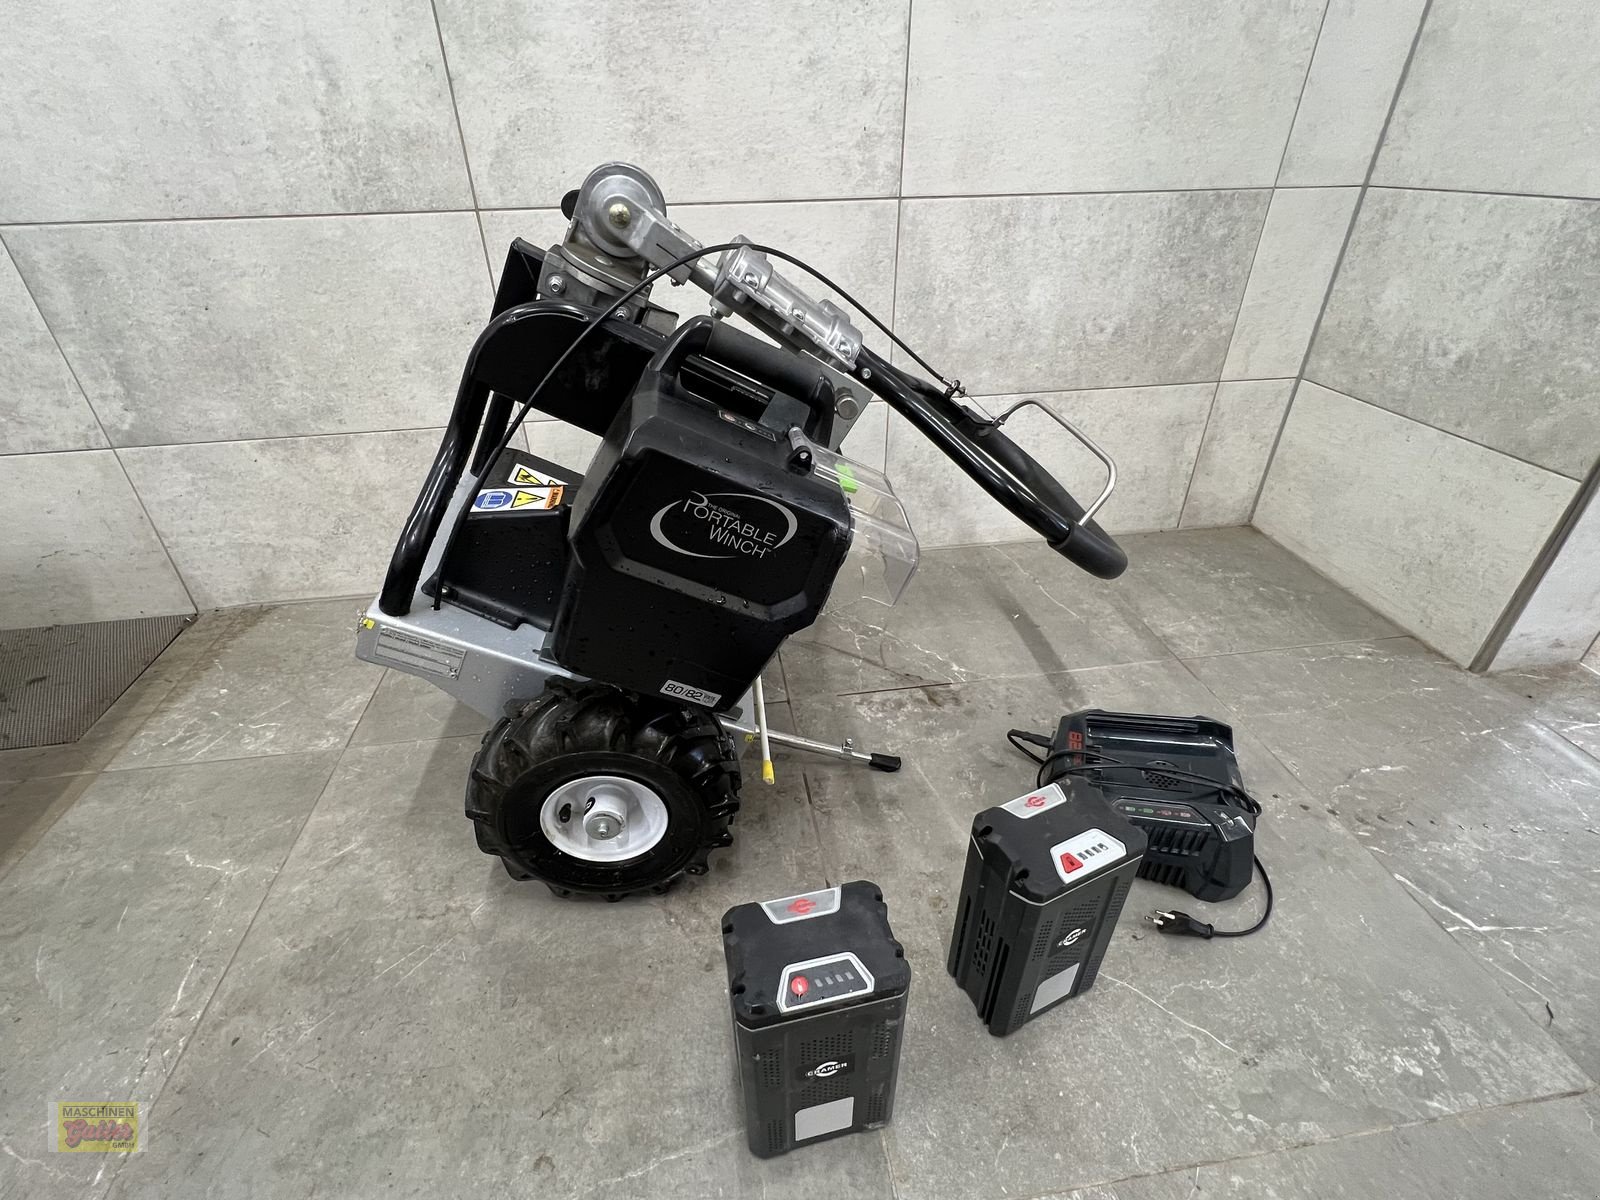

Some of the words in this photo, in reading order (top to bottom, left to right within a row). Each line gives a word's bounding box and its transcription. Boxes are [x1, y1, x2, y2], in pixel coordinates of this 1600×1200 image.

[683, 490, 777, 546] PORTABLE
[709, 524, 767, 559] WINCH
[664, 683, 703, 701] 80/82
[807, 1061, 848, 1077] CRAMER
